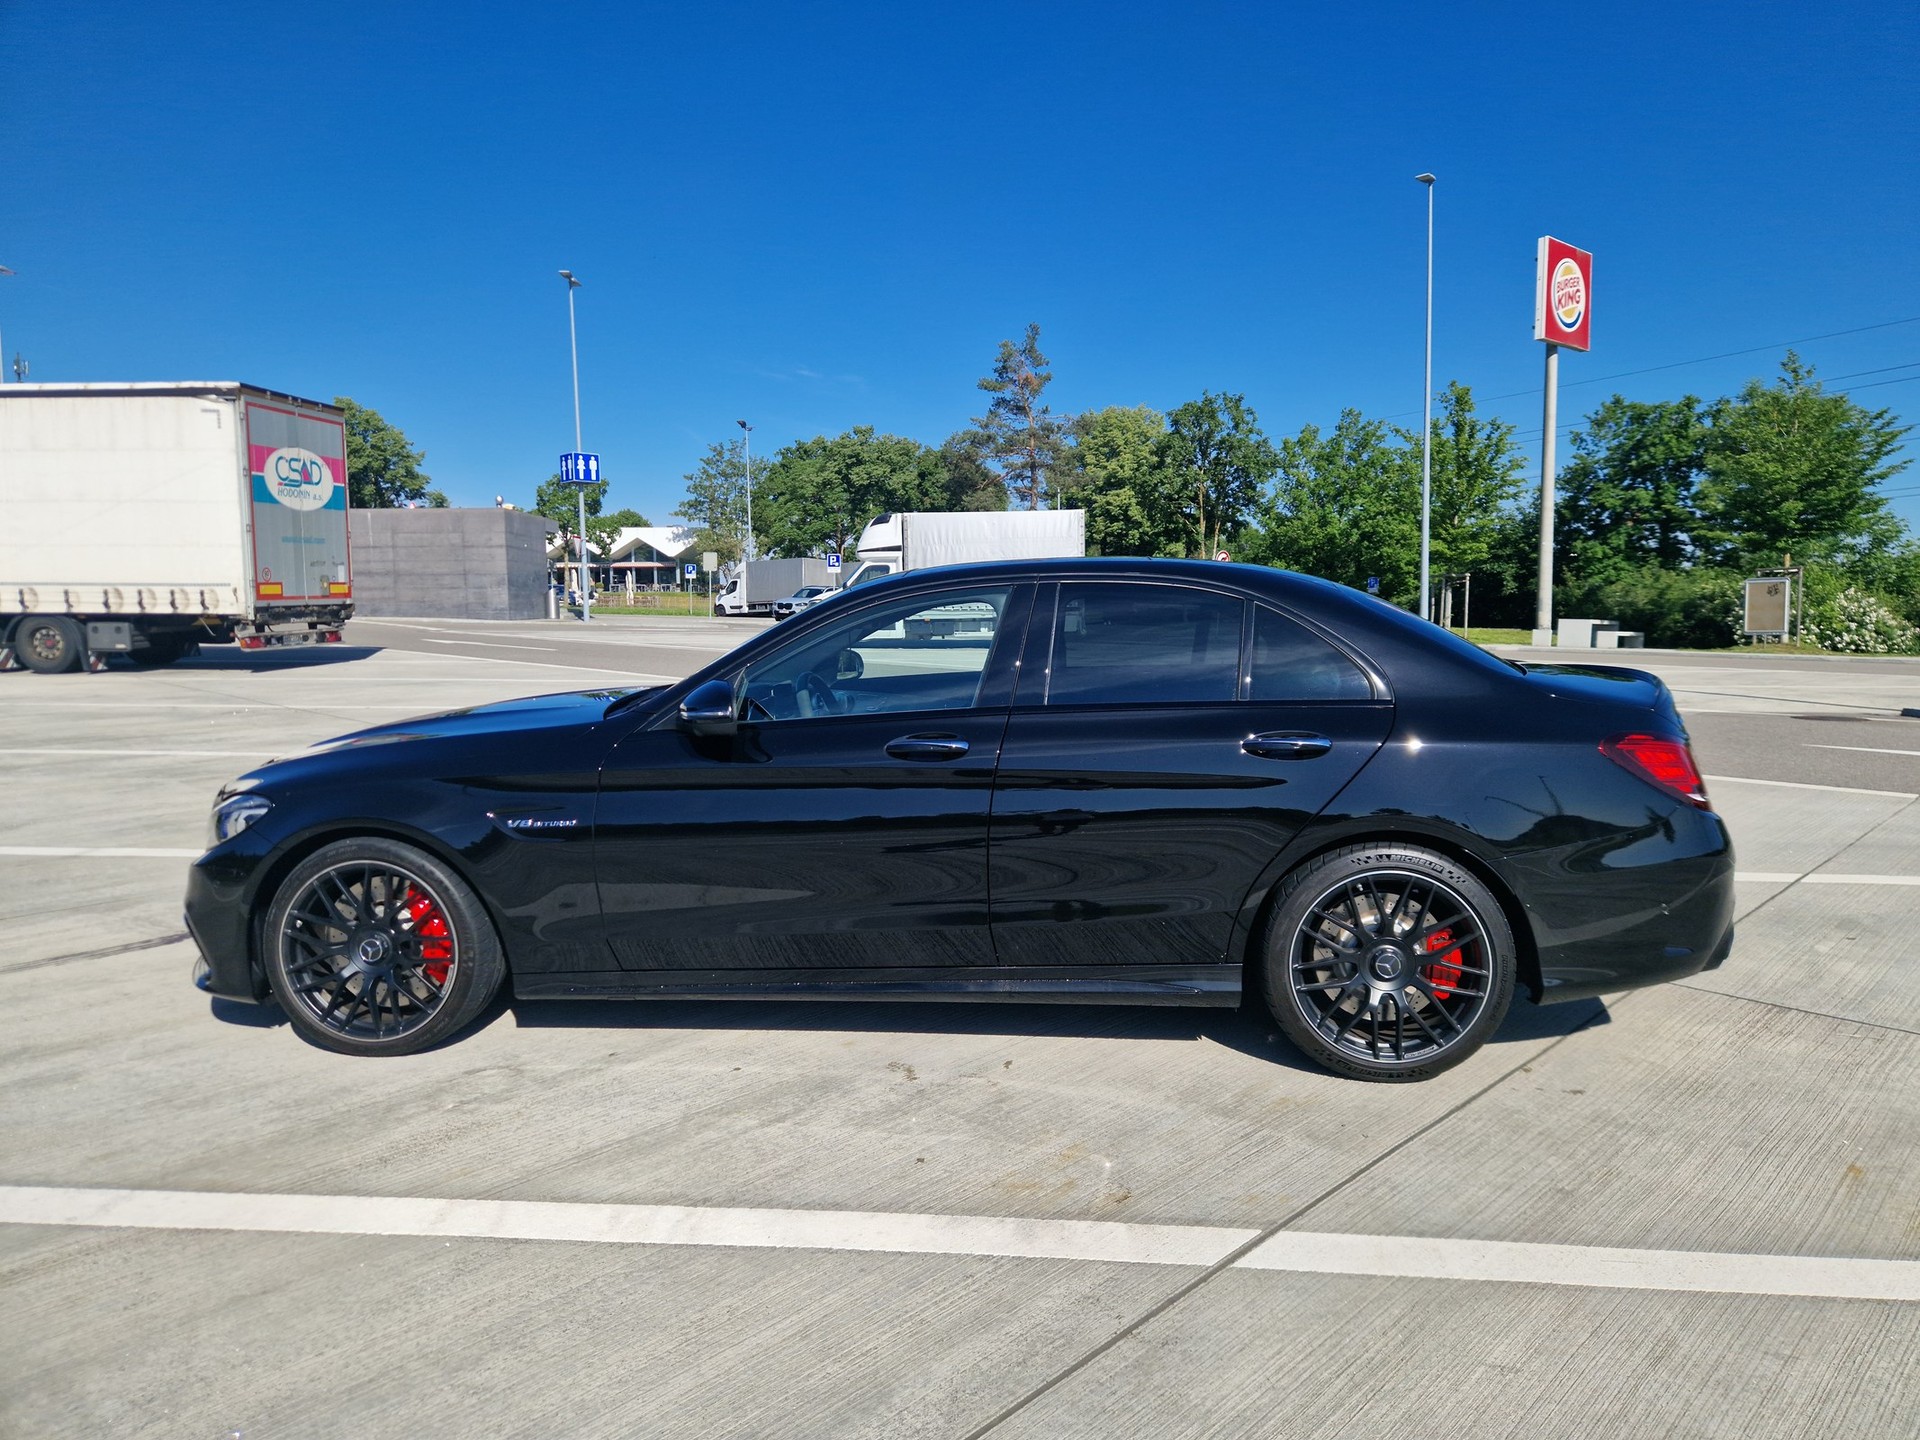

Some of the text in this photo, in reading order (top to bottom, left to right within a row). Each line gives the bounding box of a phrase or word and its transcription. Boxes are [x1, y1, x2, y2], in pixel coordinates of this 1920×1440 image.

[1556, 276, 1580, 294] BURGER
[1557, 288, 1581, 310] KING
[507, 818, 533, 828] V8
[1390, 854, 1445, 874] MICHELIN
